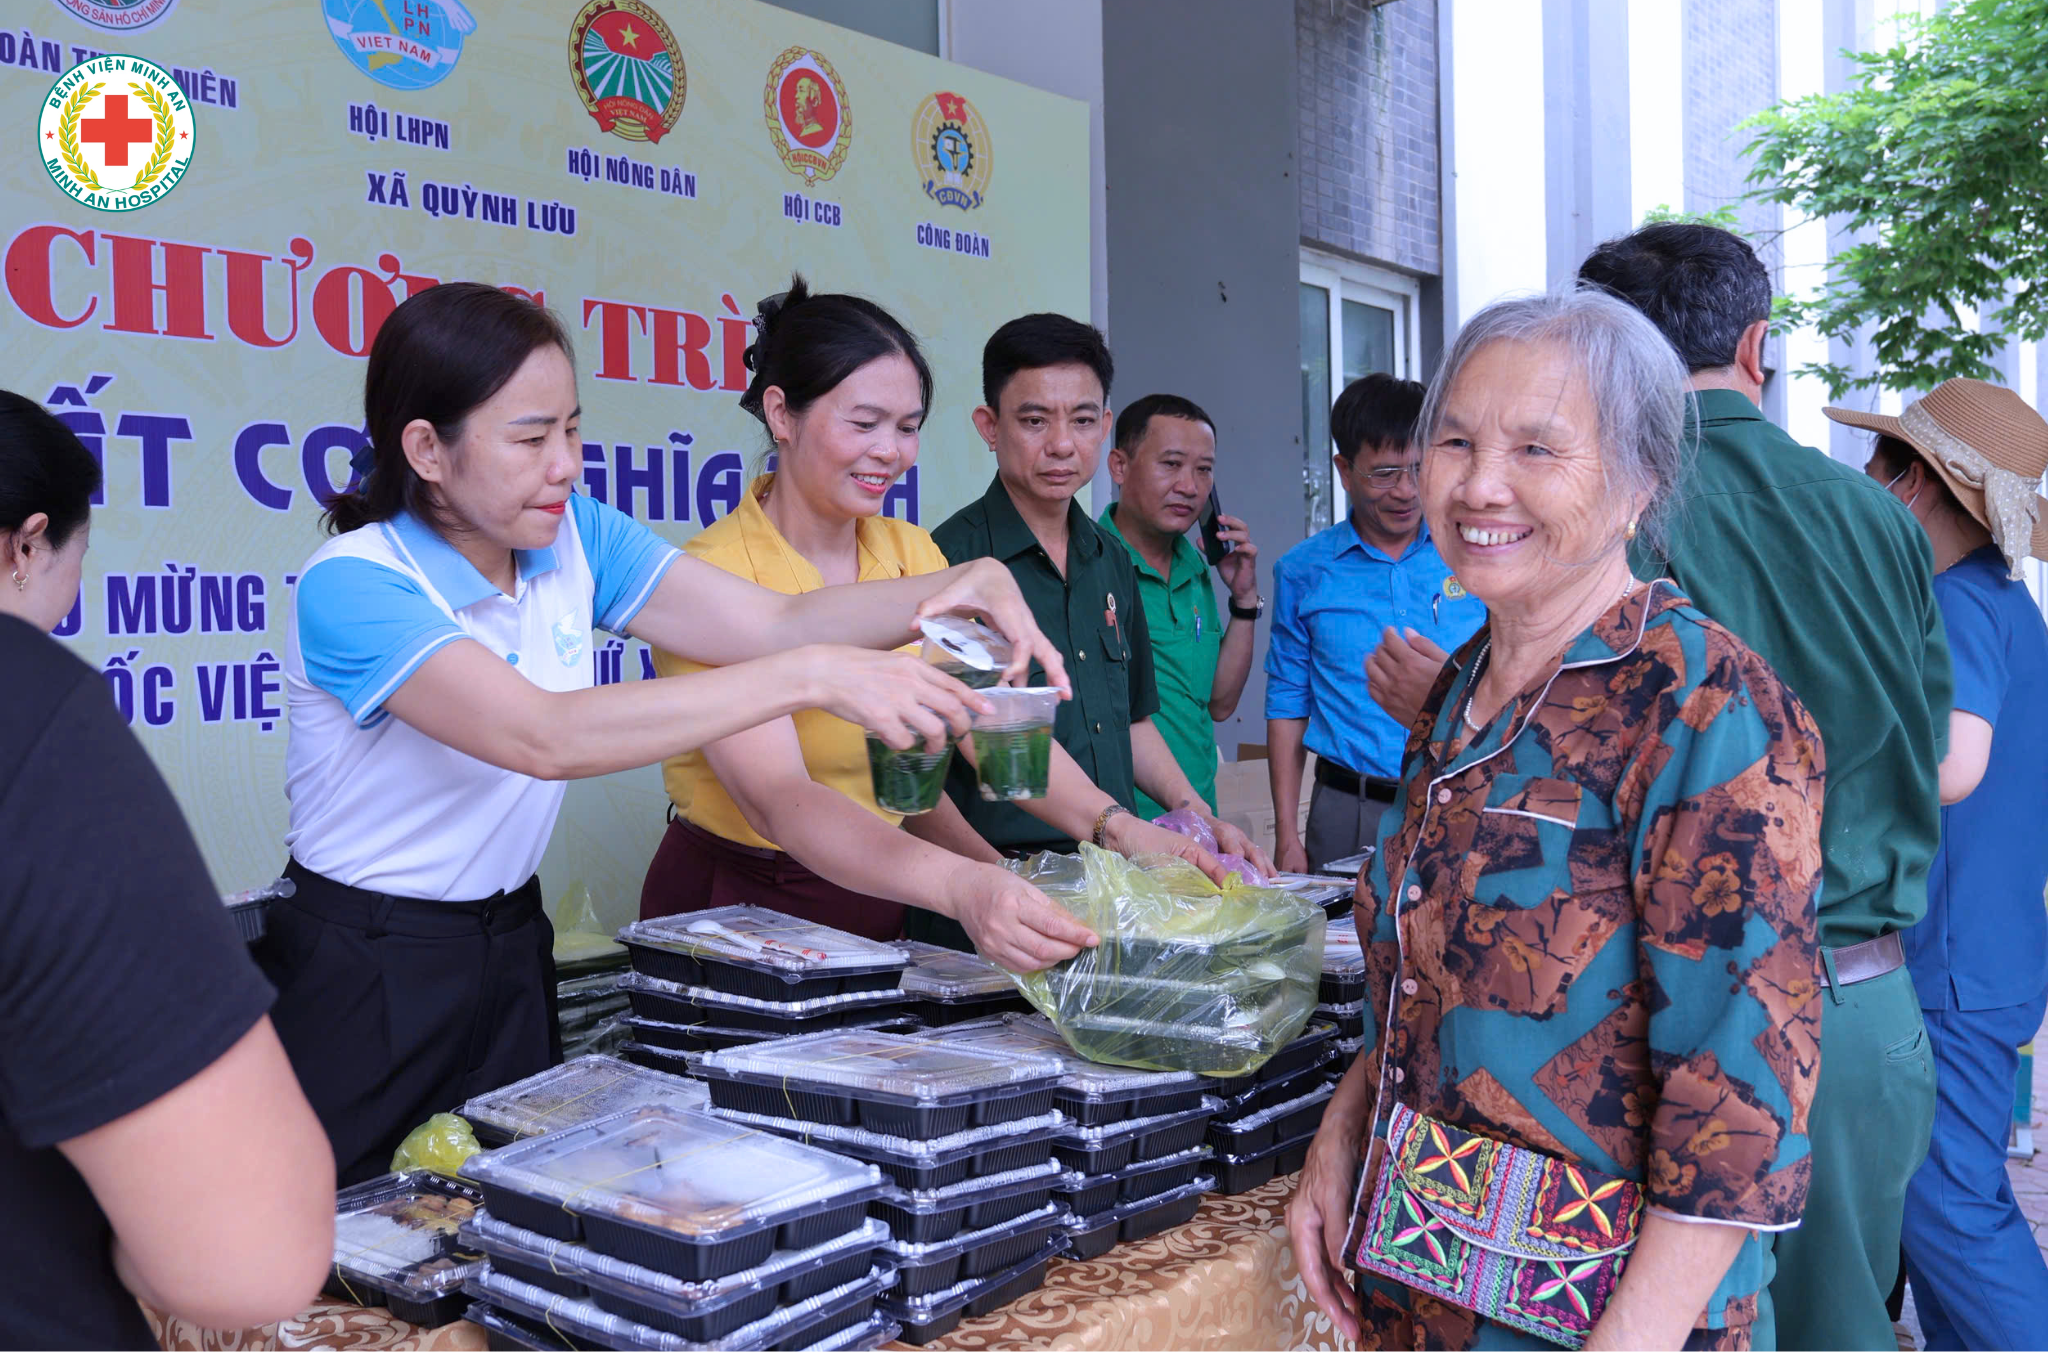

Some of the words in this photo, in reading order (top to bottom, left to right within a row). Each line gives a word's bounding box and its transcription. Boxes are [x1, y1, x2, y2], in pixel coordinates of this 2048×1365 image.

[399, 40, 431, 63] NAM
[404, 17, 430, 36] PN
[0, 31, 61, 73] OÀN
[172, 69, 237, 108] NIÊN
[350, 104, 387, 141] HỘI
[397, 115, 449, 149] LHPN
[568, 148, 600, 182] HỘI
[606, 157, 655, 190] NÔNG
[660, 168, 696, 198] DÂN
[368, 171, 410, 208] XÃ
[423, 183, 517, 226] QUỲNH
[528, 202, 575, 235] LƯU
[784, 193, 810, 224] HỘI
[814, 201, 841, 226] CCB
[917, 222, 951, 250] CÔNG
[955, 232, 989, 258] ĐOÀN
[5, 225, 544, 357] CHƯƠ
[583, 293, 753, 392] TRÌ
[234, 423, 374, 512] CƠ
[572, 432, 743, 530] GHĨA
[106, 563, 266, 634] MỪNG
[103, 651, 174, 726] ỐC
[196, 652, 282, 731] VIỆ
